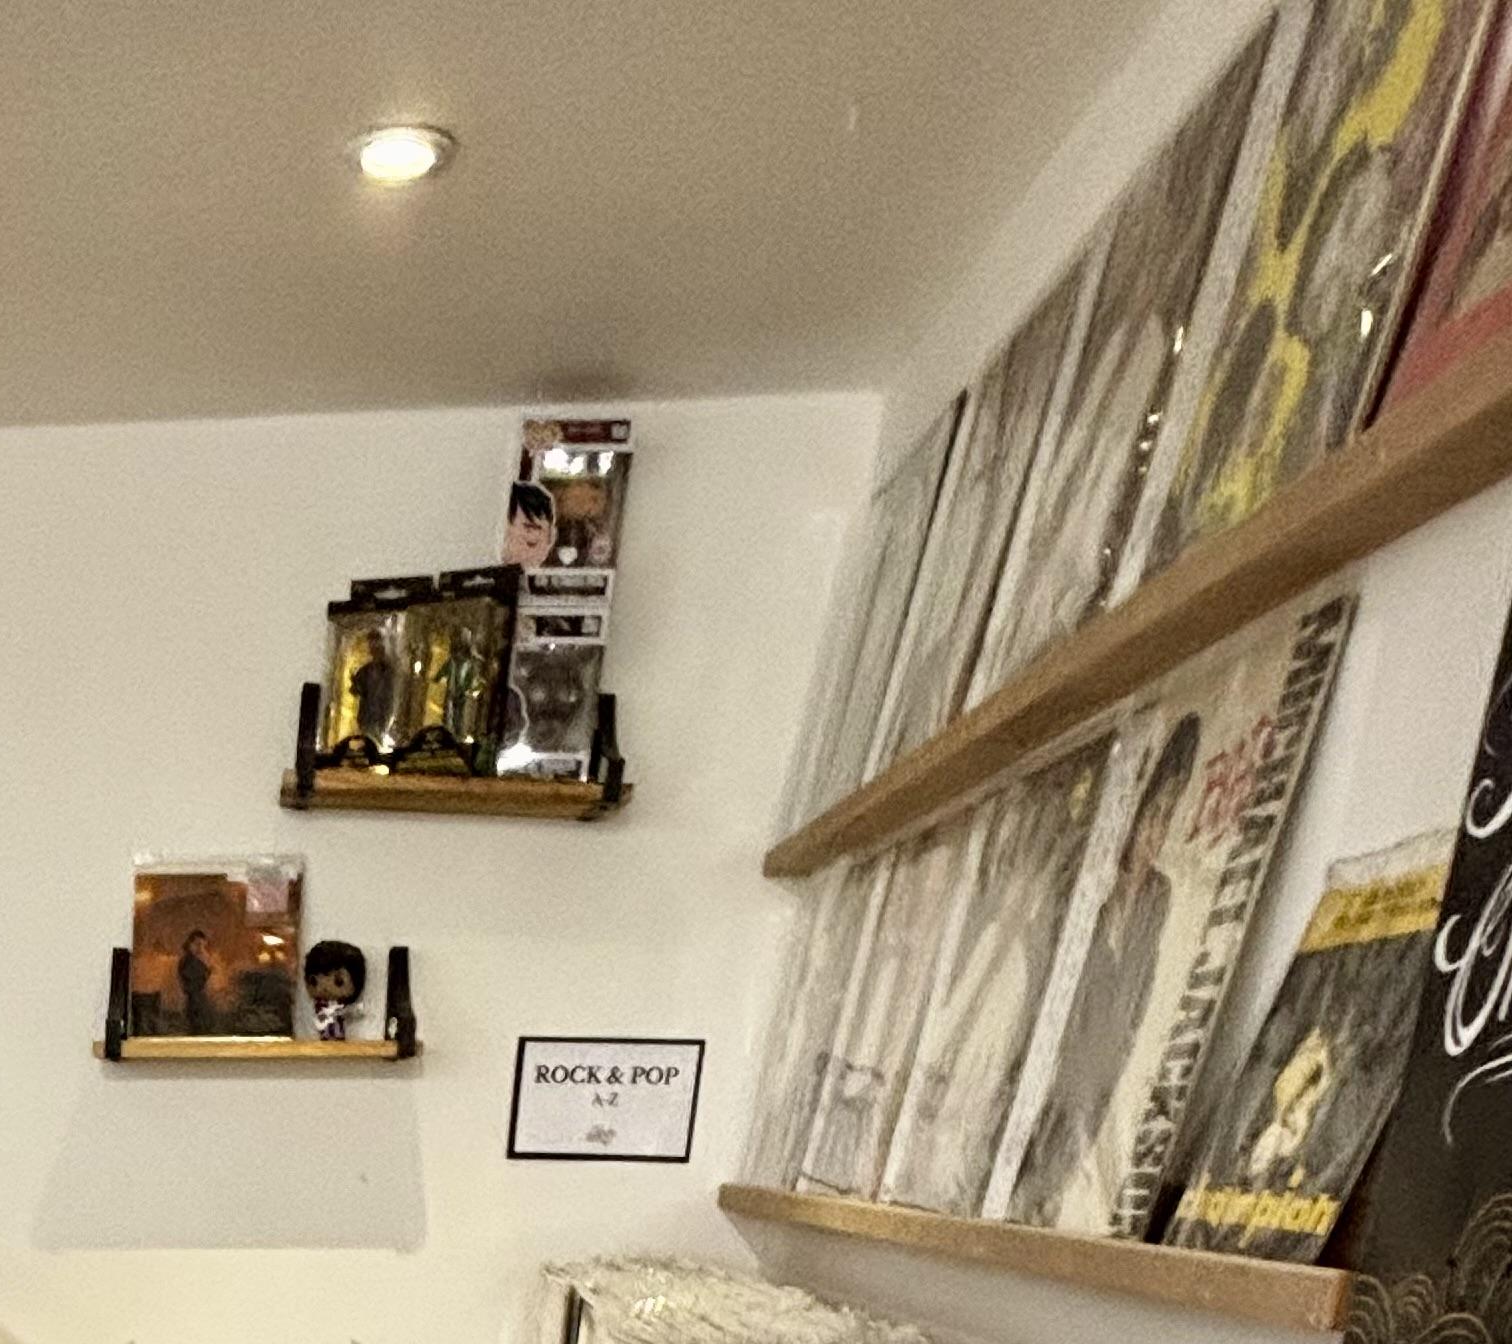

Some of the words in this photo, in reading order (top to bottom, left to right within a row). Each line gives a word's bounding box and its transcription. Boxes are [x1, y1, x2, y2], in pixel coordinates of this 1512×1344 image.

[534, 1064, 602, 1085] ROCK
[606, 1065, 624, 1085] &
[630, 1065, 680, 1085] POP
